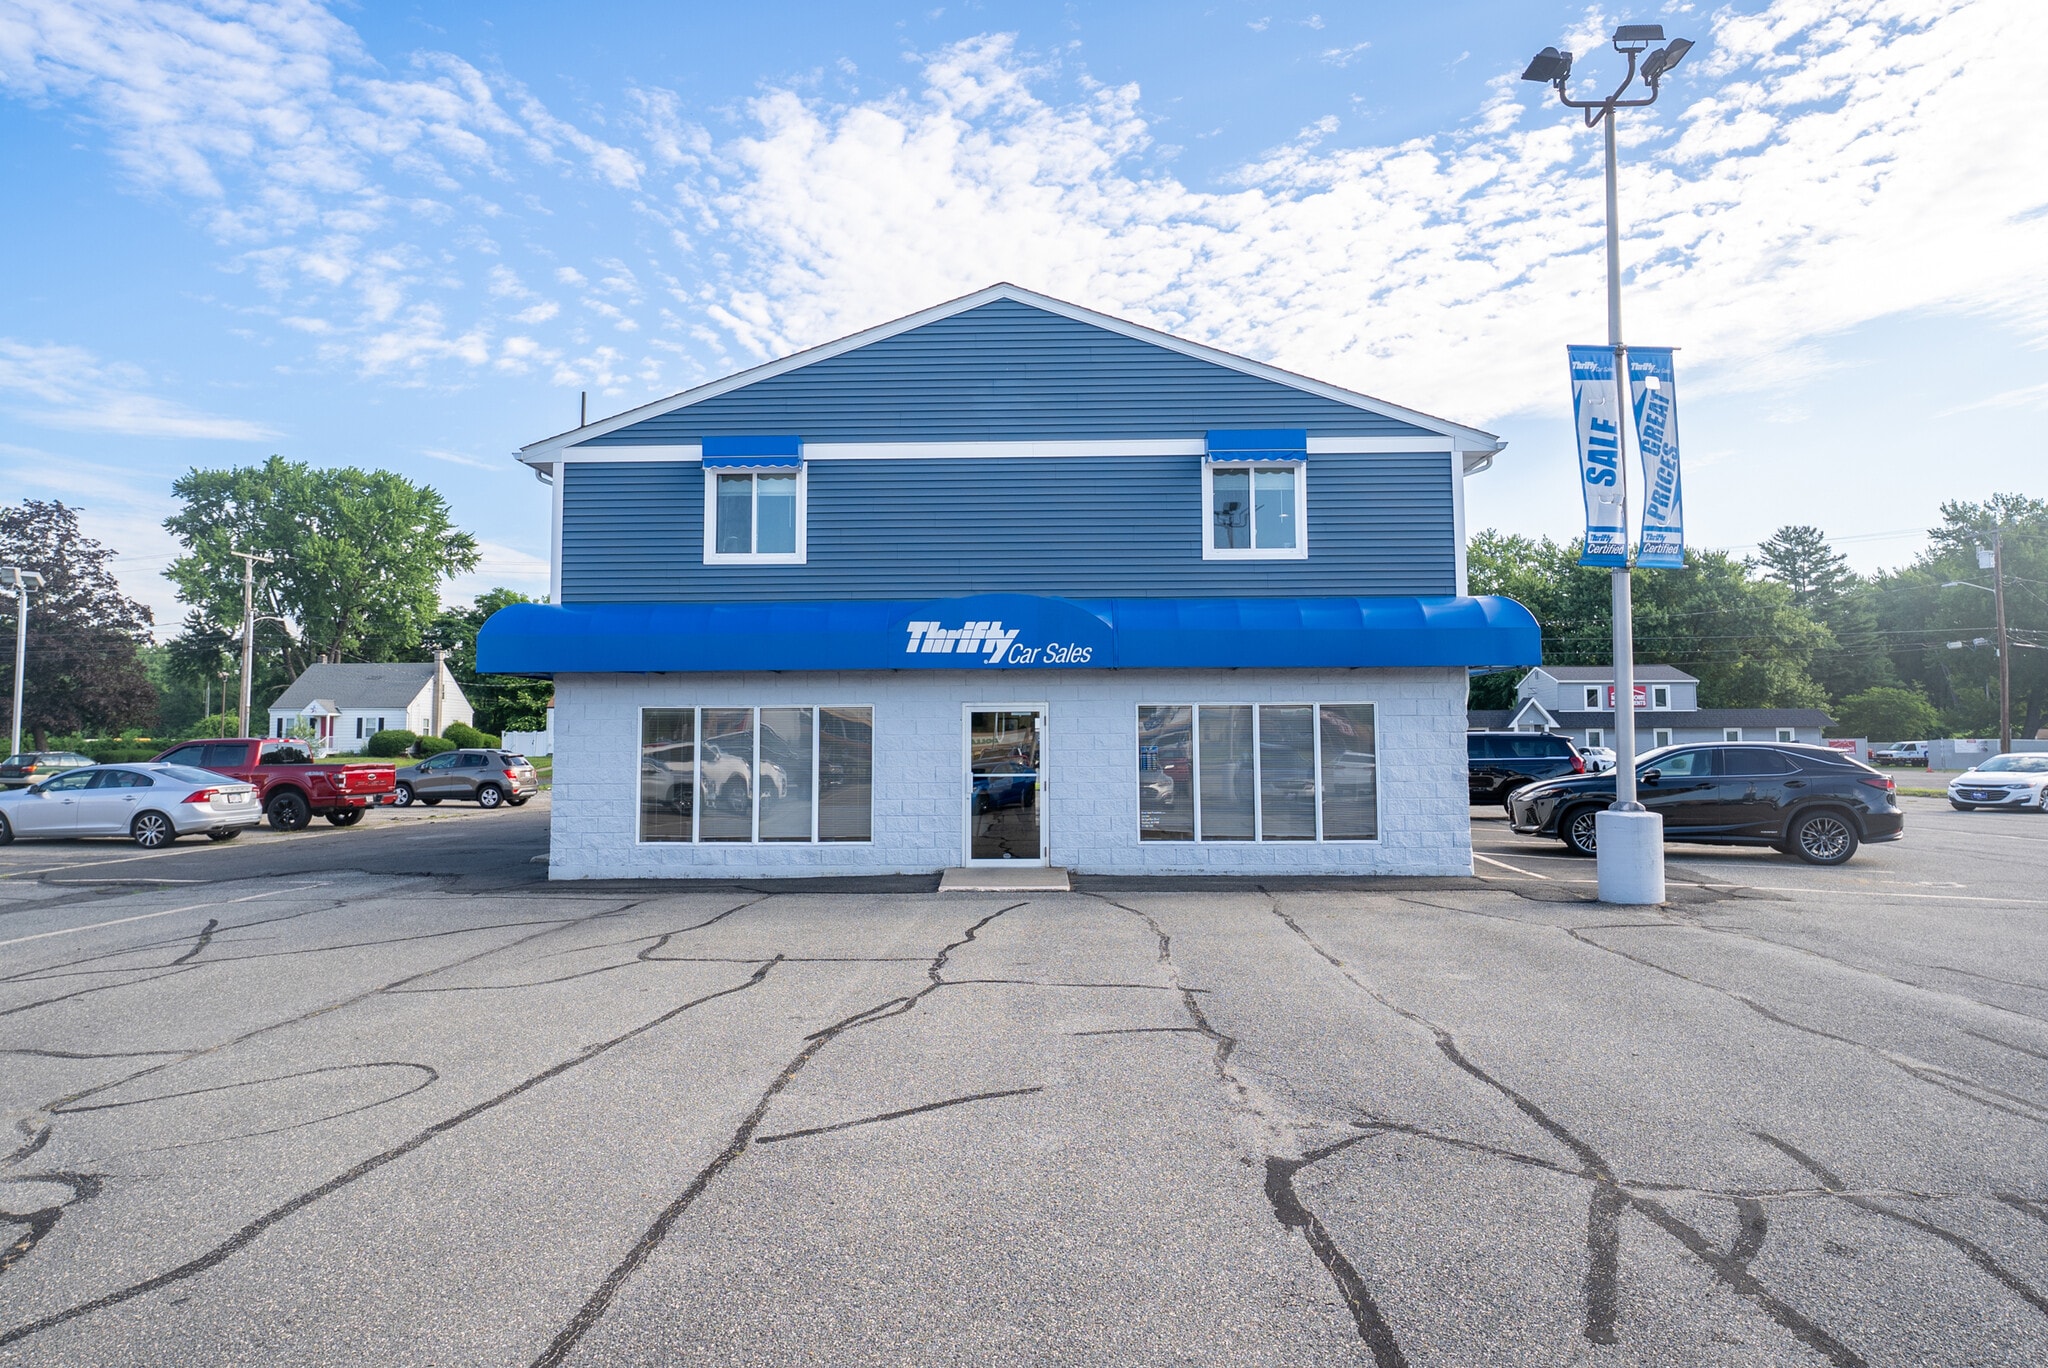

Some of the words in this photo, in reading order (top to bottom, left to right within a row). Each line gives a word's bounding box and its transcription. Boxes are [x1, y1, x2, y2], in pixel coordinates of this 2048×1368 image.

[1572, 361, 1598, 372] Thrifty
[1630, 362, 1656, 373] Thrifty
[1641, 389, 1670, 457] GREAT
[1586, 417, 1618, 487] SALE
[1647, 442, 1678, 522] PRICES
[1590, 533, 1613, 543] Thrifty
[1645, 533, 1666, 543] Thrifty
[1587, 543, 1625, 555] Certified
[1643, 542, 1679, 554] Certified
[906, 621, 1020, 664] Thrifty
[1008, 643, 1041, 664] Car
[1043, 642, 1092, 663] Sales
